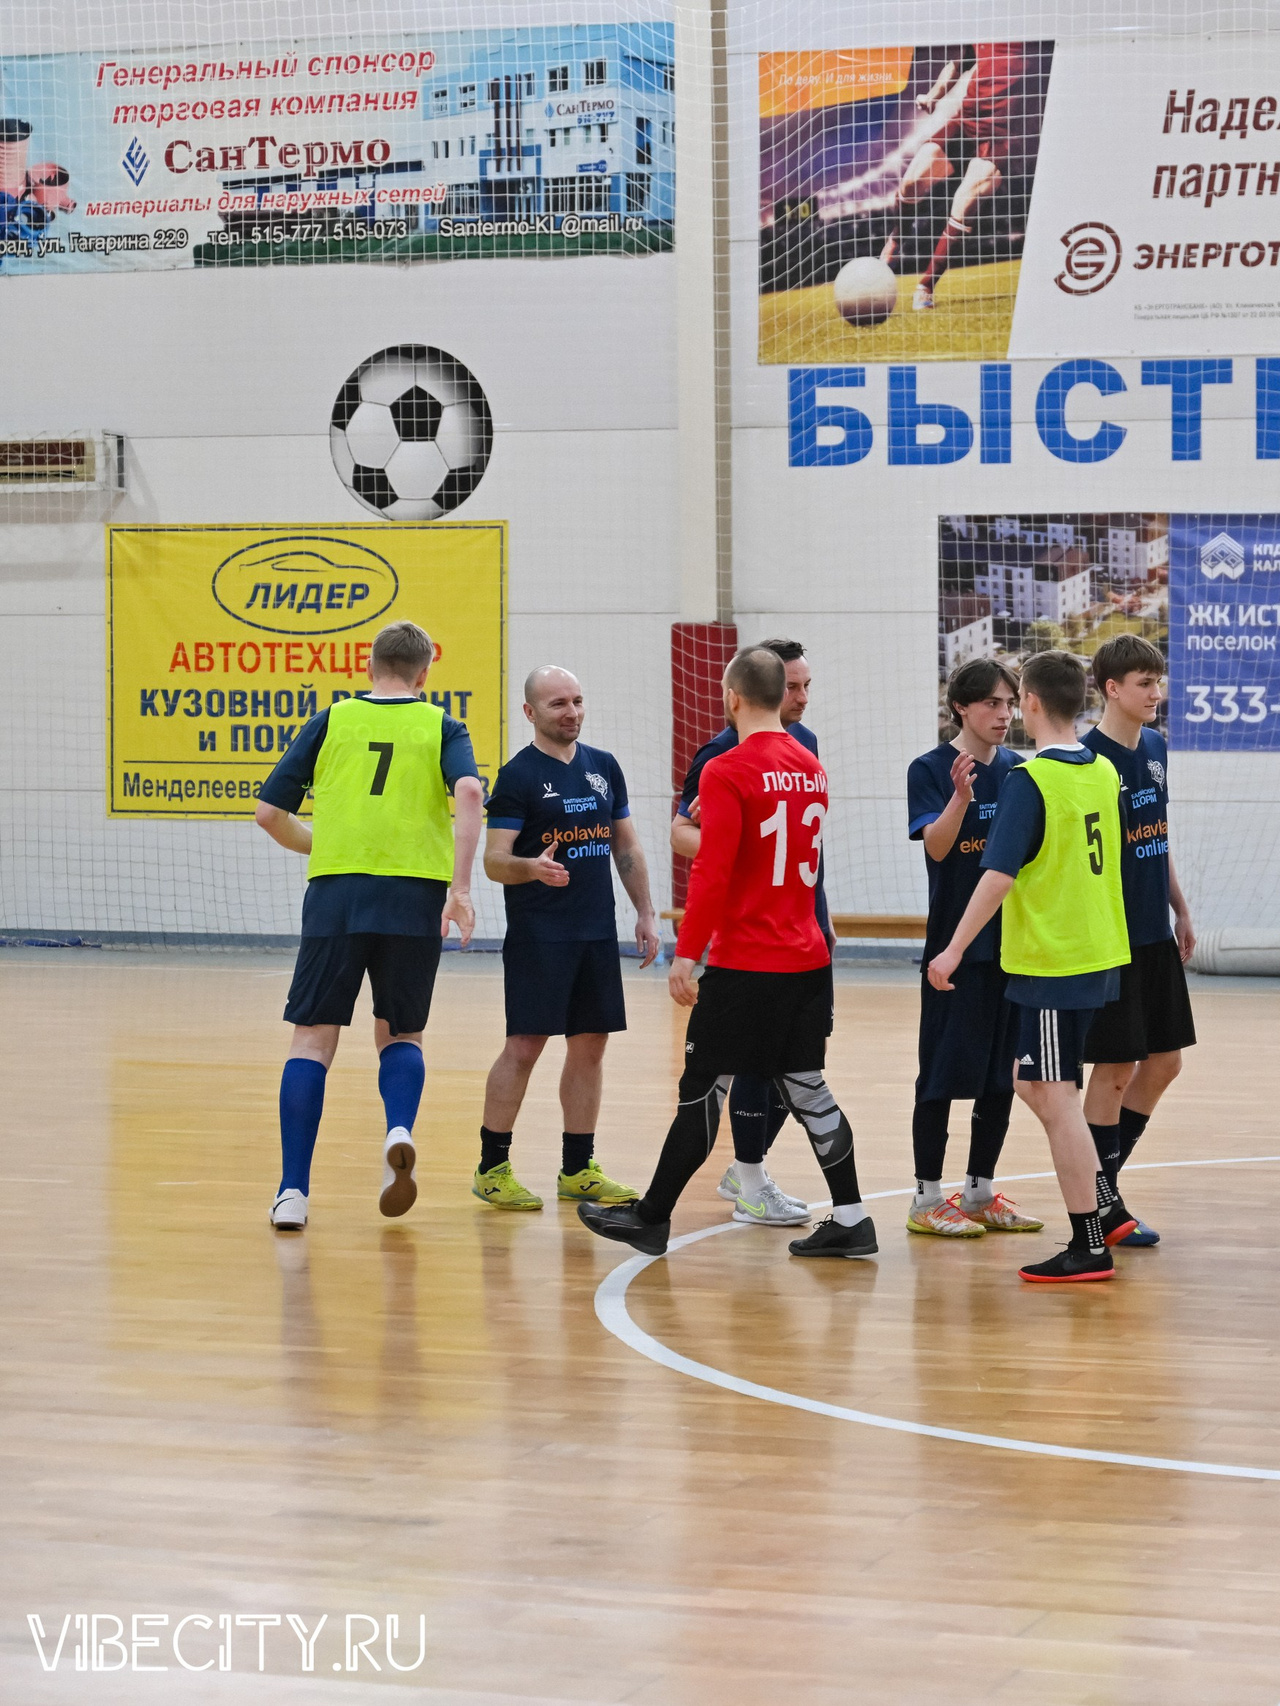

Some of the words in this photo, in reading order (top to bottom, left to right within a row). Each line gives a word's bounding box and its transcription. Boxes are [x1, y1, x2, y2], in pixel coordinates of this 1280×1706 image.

[96, 51, 298, 90] Генеральный
[307, 50, 435, 78] спонсор
[113, 97, 260, 128] торговая
[270, 89, 418, 117] компания
[164, 135, 391, 177] СанТермо
[86, 196, 212, 218] материалы
[218, 191, 256, 211] для
[262, 188, 373, 212] наружных
[376, 182, 446, 204] сетей
[37, 237, 65, 257] ул.
[68, 232, 149, 255] Гагарина
[153, 228, 188, 249] 229
[208, 230, 244, 246] тел.
[252, 224, 326, 245] 515-777,
[333, 221, 407, 240] 515-073
[440, 213, 643, 238] Santermo-KL@mail.ru
[245, 583, 370, 613] ЛИДЕР
[1188, 604, 1231, 626] ЖК
[1187, 634, 1276, 651] поселок
[139, 683, 317, 718] КУЗОВНОЙ
[199, 730, 216, 752] и
[369, 742, 394, 796] 7
[762, 770, 828, 794] ЛЮТЫЙ
[564, 801, 598, 814] ШТОРМ
[542, 823, 612, 844] ekolavka.
[567, 841, 610, 859] online
[760, 800, 826, 888] 13
[1084, 812, 1103, 875] 5
